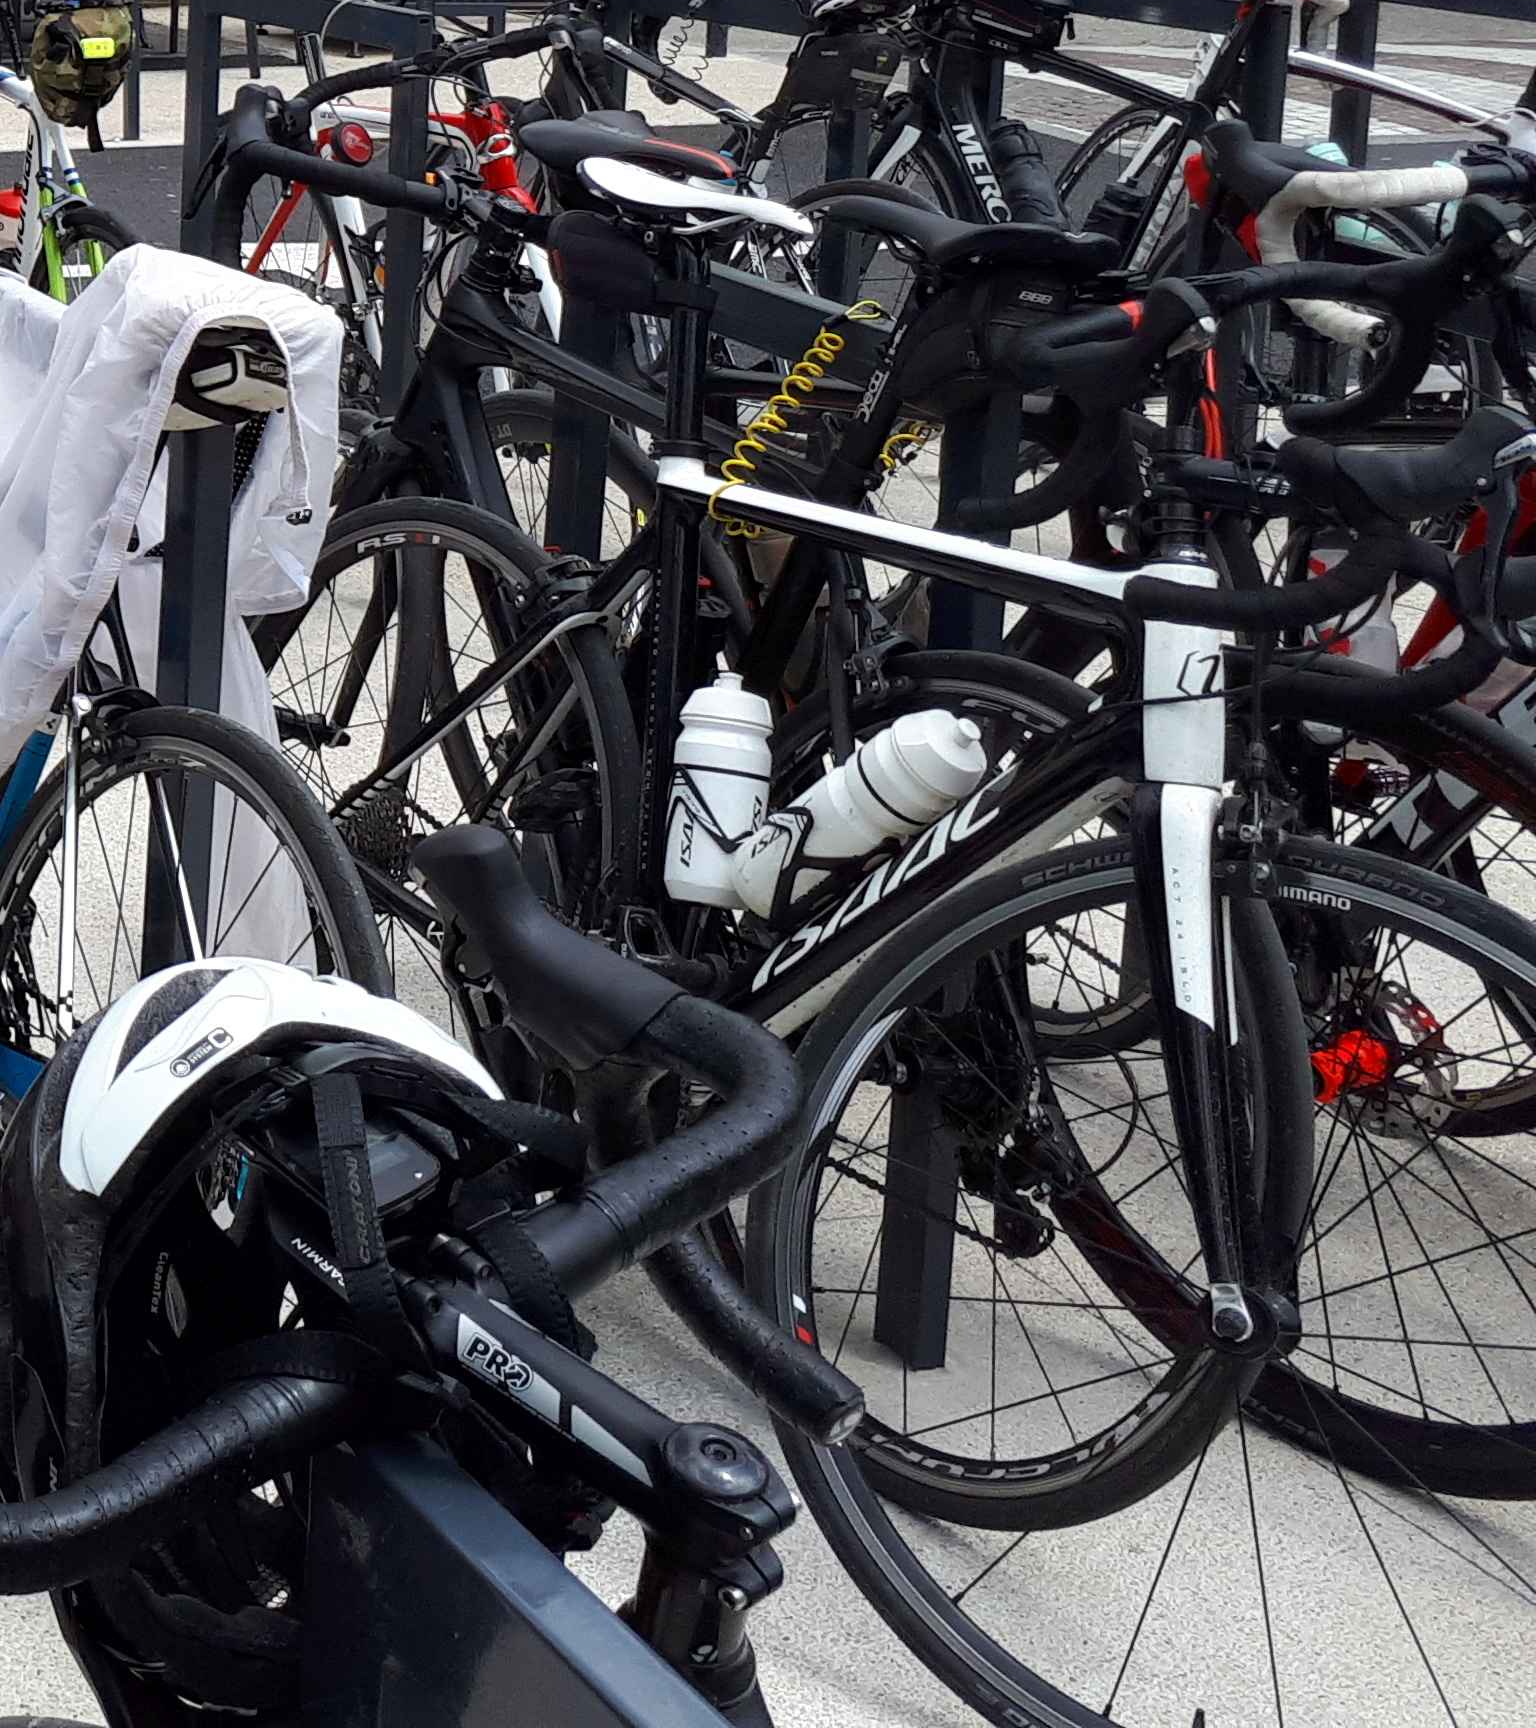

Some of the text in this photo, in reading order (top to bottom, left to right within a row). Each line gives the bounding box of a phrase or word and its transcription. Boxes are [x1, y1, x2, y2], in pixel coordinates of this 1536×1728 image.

[357, 533, 407, 553] RS
[1278, 884, 1352, 913] IMANO
[464, 1332, 535, 1393] PRO
